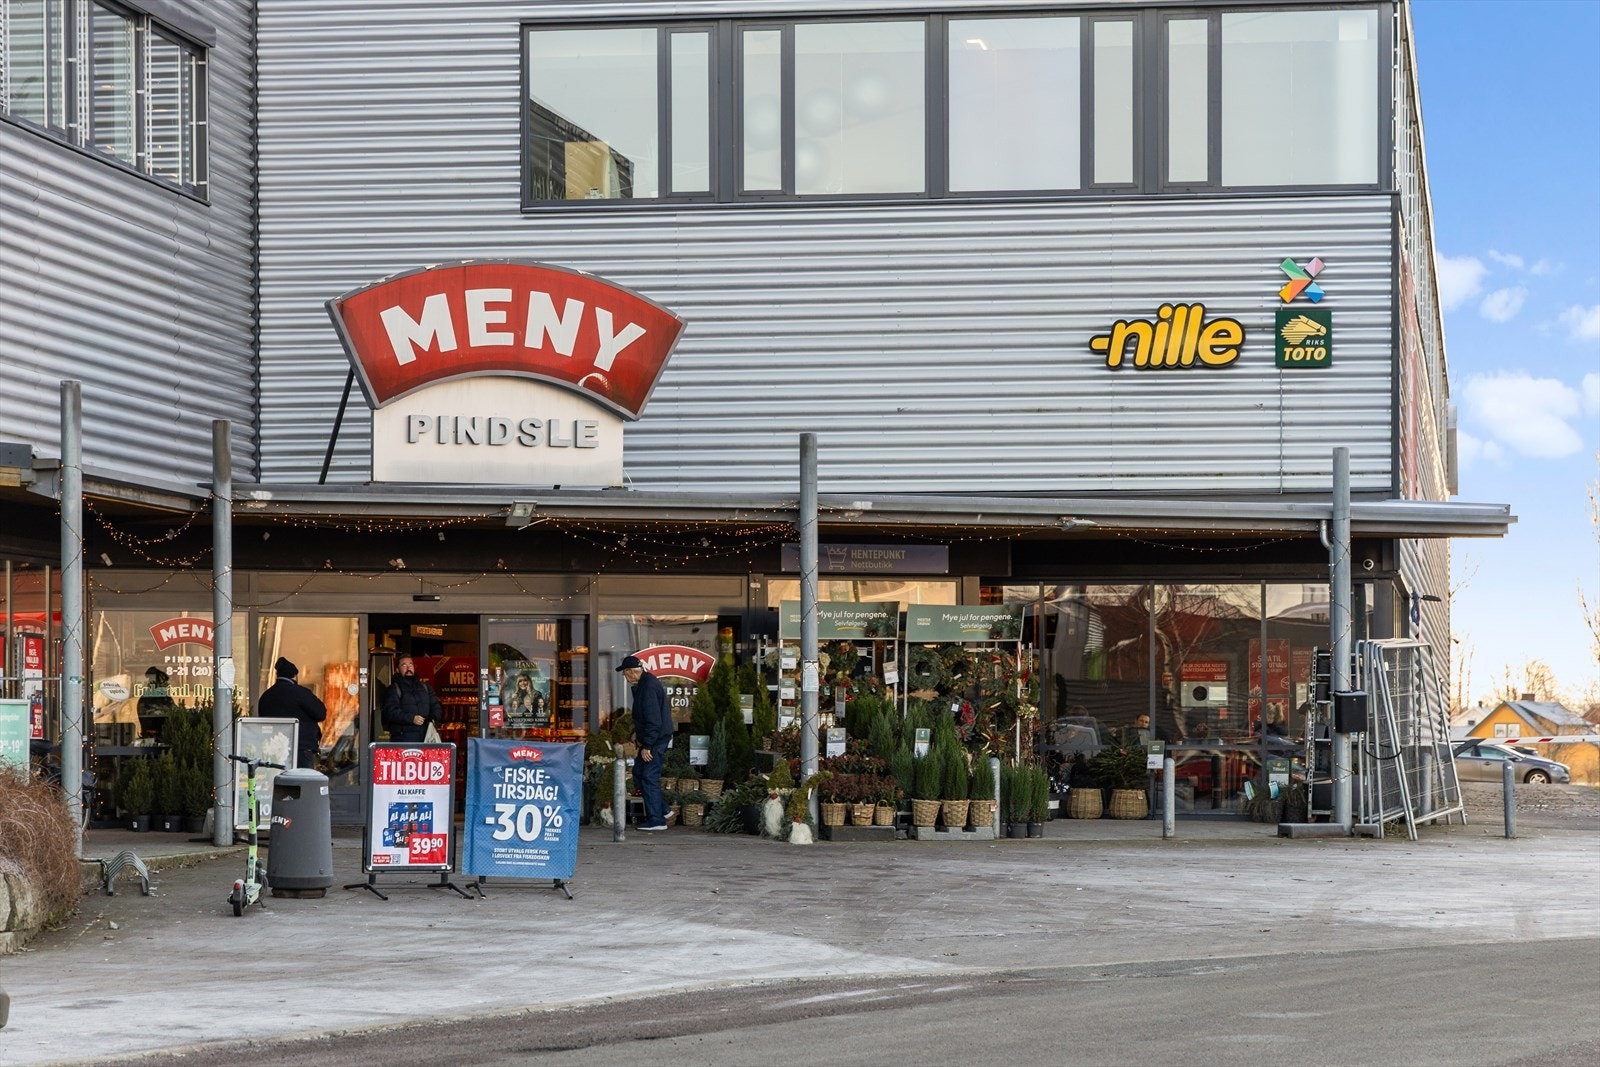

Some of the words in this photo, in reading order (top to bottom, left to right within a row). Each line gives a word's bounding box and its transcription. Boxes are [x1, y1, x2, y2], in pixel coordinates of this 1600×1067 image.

[379, 288, 647, 372] MENY
[1090, 303, 1245, 369] nille
[1283, 347, 1326, 361] TOTO
[407, 414, 600, 449] PINDSLE
[851, 550, 906, 560] HENTEPUNKT
[851, 561, 894, 569] Nettbutikk
[833, 611, 843, 620] jul
[855, 612, 889, 620] pengene.
[942, 613, 958, 622] Mye
[958, 613, 969, 622] jul
[980, 614, 1013, 623] pengene.
[159, 624, 214, 642] MENY
[641, 653, 705, 674] MENY
[166, 667, 189, 676] 8-21
[192, 666, 212, 677] (20)
[449, 672, 475, 684] MER
[667, 687, 698, 695] DSLE
[671, 698, 689, 707] (20)
[512, 749, 540, 759] MENY
[504, 767, 551, 784] FISKE-
[493, 783, 559, 801] TIRSDAG!
[485, 803, 563, 842] -30%
